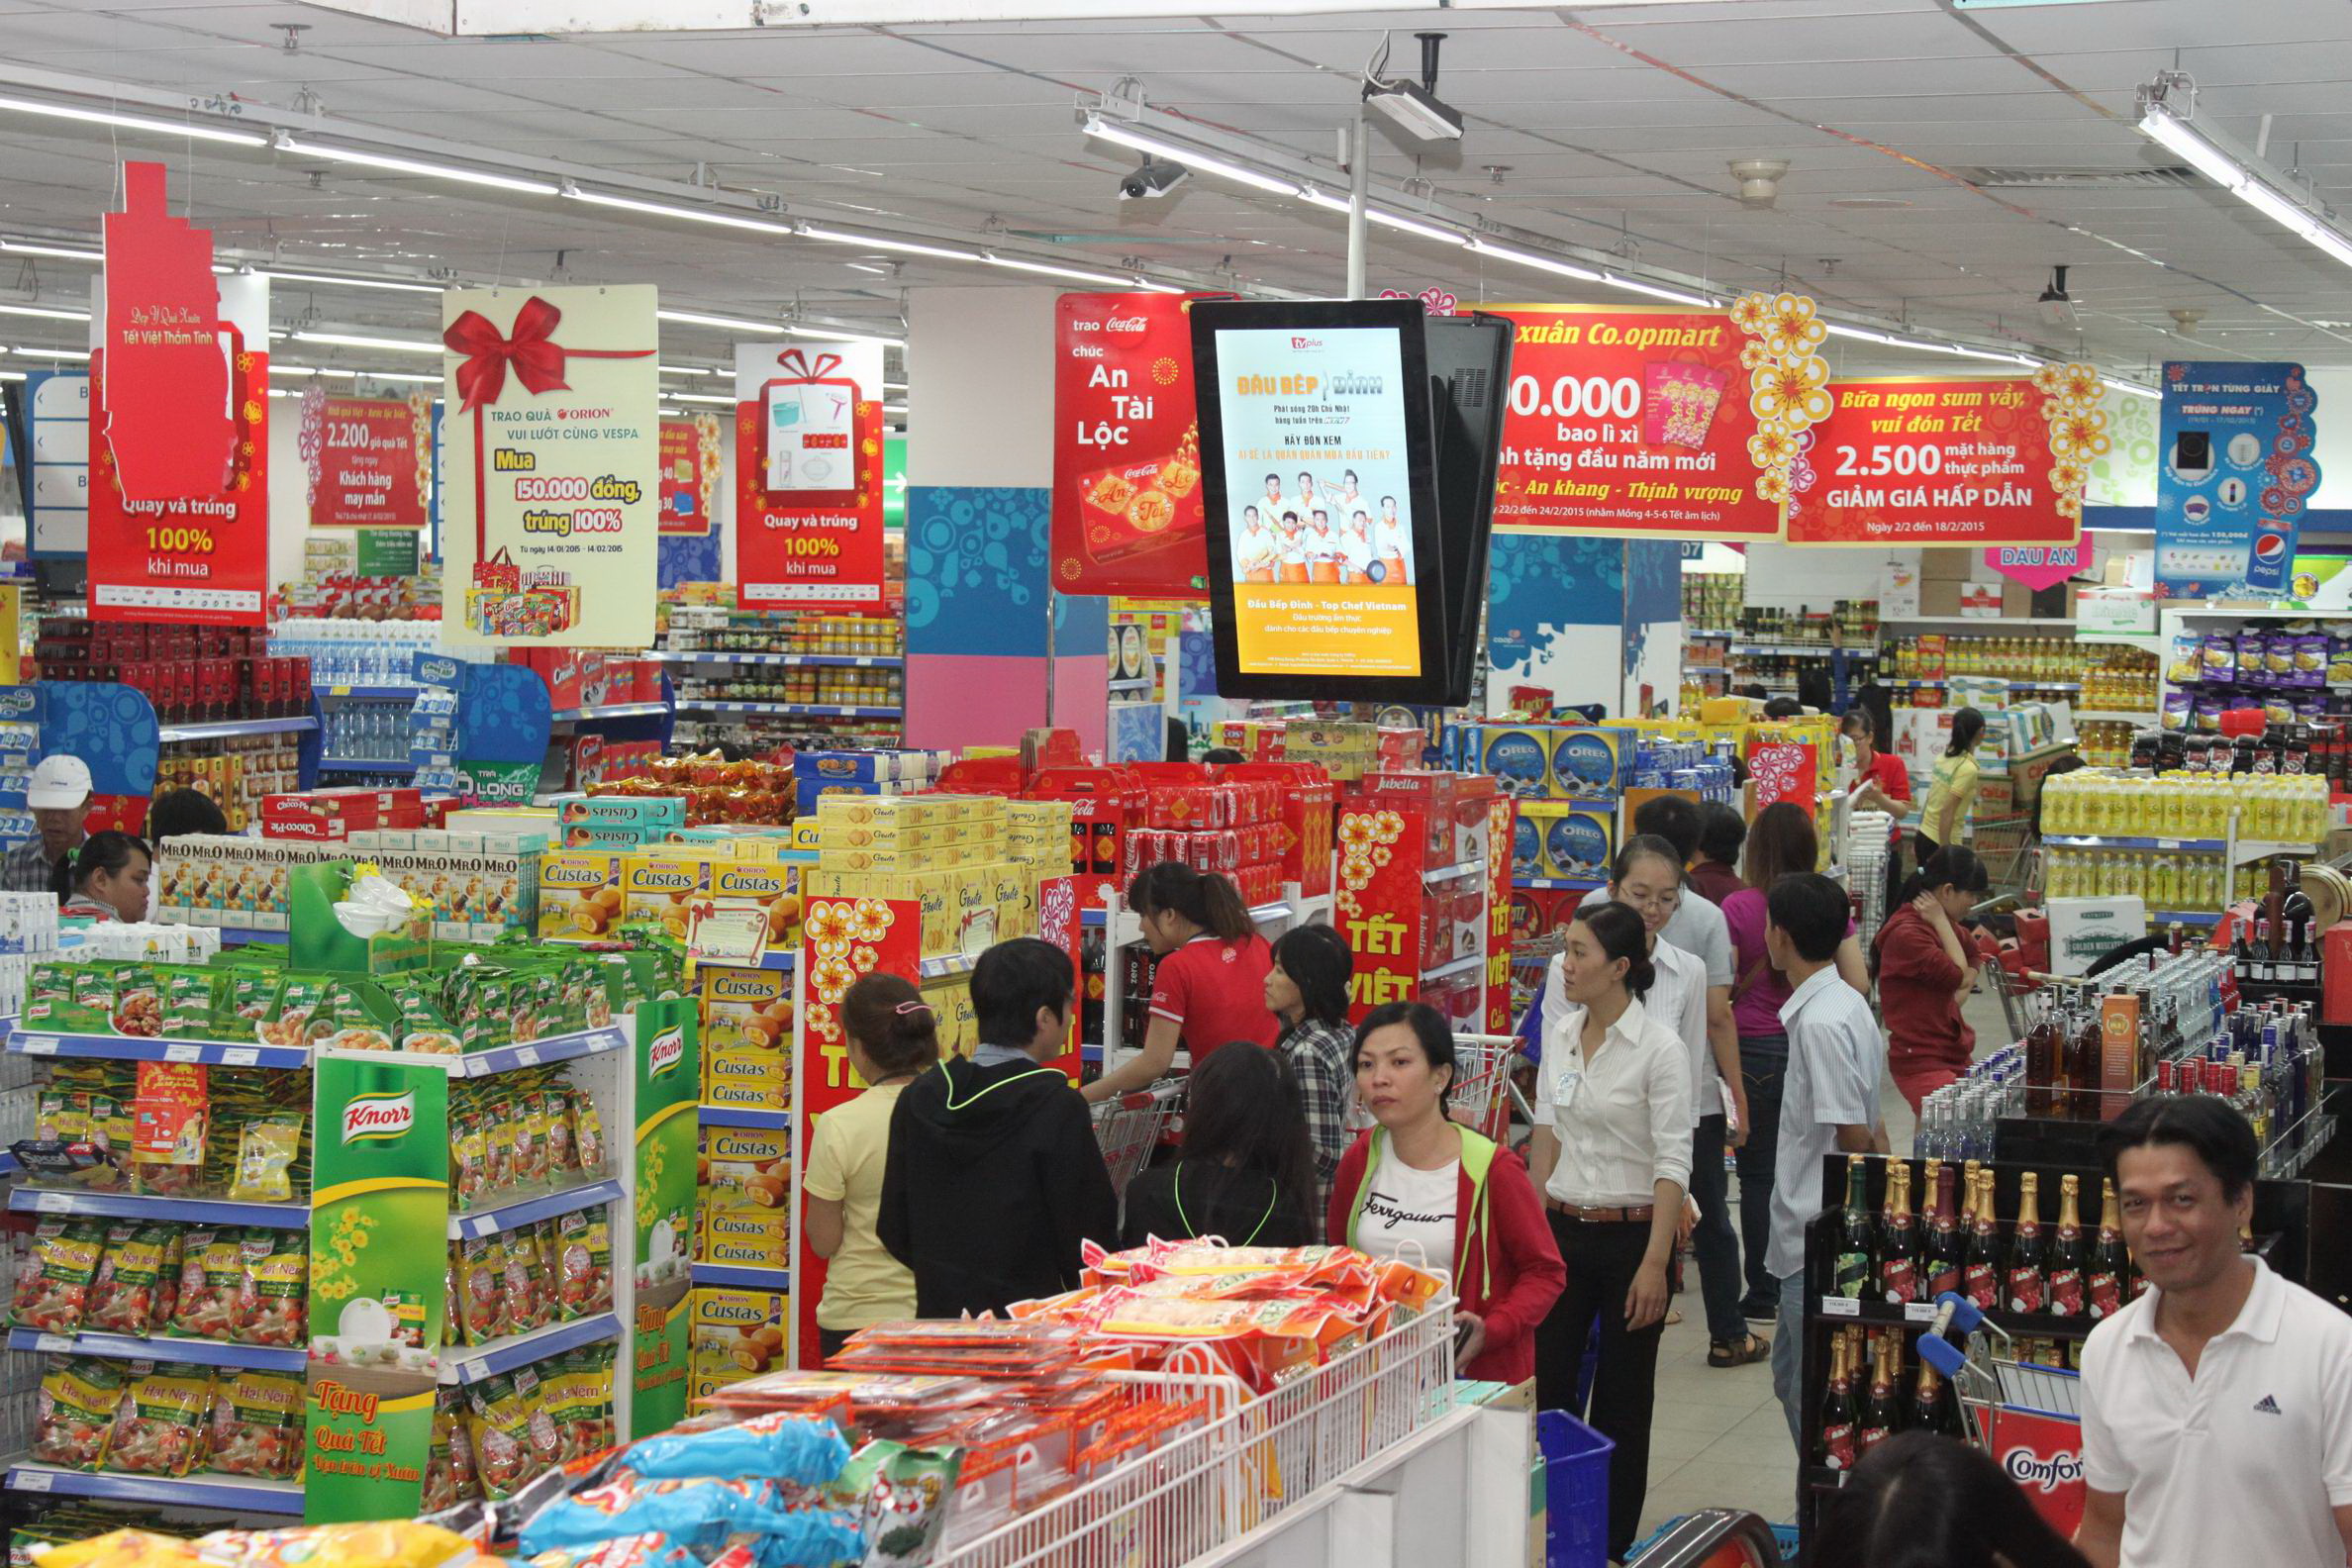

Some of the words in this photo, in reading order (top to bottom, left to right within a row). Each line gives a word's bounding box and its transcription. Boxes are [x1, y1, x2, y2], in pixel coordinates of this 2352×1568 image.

[1073, 320, 1101, 332] trao
[1106, 317, 1148, 333] Coca-Cola
[123, 328, 139, 344] Tết
[142, 331, 162, 346] Việt
[1516, 320, 1581, 344] xuân
[1588, 323, 1721, 350] Co.opmart
[1072, 344, 1104, 357] chúc
[1088, 364, 1127, 388] An
[1280, 372, 1320, 395] BẾP
[1504, 376, 1641, 419] 0.000
[1840, 391, 1880, 408] Bữa
[1886, 394, 1935, 411] ngon
[1940, 394, 1983, 406] sum
[491, 412, 522, 422] TRAO
[526, 408, 551, 422] QUÀ
[570, 409, 610, 419] ORION
[1111, 395, 1153, 420] Tài
[1290, 404, 1306, 414] sóng
[2182, 404, 2218, 415] TRÚNG
[2220, 406, 2252, 415] NGAY
[1871, 416, 1903, 433] vui
[1907, 415, 1946, 434] đón
[1951, 410, 1983, 433] Tết
[327, 423, 369, 447] 2.200
[396, 436, 408, 448] Tết
[508, 430, 526, 440] VUI
[531, 427, 559, 440] LƯỚT
[563, 427, 598, 439] CÙNG
[603, 429, 638, 439] VESPA
[1077, 421, 1129, 450] Lộc
[1323, 437, 1341, 445] XEM
[1558, 423, 1598, 443] bao
[1602, 423, 1616, 442] lì
[1619, 424, 1639, 442] xì
[495, 449, 535, 470] Mua
[1524, 450, 1571, 471] tặng
[1577, 447, 1617, 469] đầu
[1623, 452, 1671, 470] năm
[1675, 451, 1715, 470] mới
[1835, 445, 1941, 476] 2.500
[1945, 442, 1975, 459] mặt
[1978, 443, 2016, 459] hàng
[1944, 462, 1978, 477] thực
[1982, 459, 2024, 477] phẩm
[340, 471, 366, 485] Khách
[368, 472, 392, 490] hàng
[516, 478, 588, 500] 150.000
[591, 475, 641, 504] đồng,
[345, 495, 363, 509] may
[365, 489, 385, 505] mắn
[1525, 480, 1549, 495] An
[1553, 481, 1610, 501] khang
[1628, 482, 1679, 500] Thịnh
[1685, 487, 1743, 504] vượng
[1827, 485, 1885, 508] GIẢM
[1890, 484, 1927, 508] GIÁ
[1933, 483, 1979, 507] HẤP
[1984, 482, 2032, 507] DẪN
[123, 498, 164, 517] Quay
[168, 497, 187, 515] và
[191, 498, 237, 520] trúng
[1499, 506, 1519, 515] 22/2
[1520, 505, 1537, 516] đến
[1539, 506, 1584, 517] 24/2/2015
[1586, 506, 1615, 519] (nhằm
[1617, 507, 1643, 521] Mồng
[1645, 510, 1668, 519] 4-5-6
[1670, 508, 1684, 520] Tết
[1685, 510, 1700, 520] âm
[1701, 510, 1720, 523] lịch)
[524, 510, 571, 537] trúng
[573, 509, 622, 532] 100%
[764, 515, 800, 532] Quay
[802, 515, 819, 528] và
[821, 515, 858, 530] trúng
[1867, 523, 1894, 533] Ngày
[1895, 523, 1911, 532] 2/2
[1912, 522, 1933, 532] đến
[1935, 523, 1985, 532] 18/2/2015
[147, 528, 213, 551] 100%
[784, 538, 839, 556] 100%
[148, 557, 170, 575] khi
[175, 562, 209, 576] mua
[786, 561, 806, 574] khi
[809, 565, 836, 574] mua
[2254, 566, 2280, 577] pepsi
[1269, 599, 1287, 611] Bếp
[1321, 601, 1338, 611] Top
[1341, 601, 1363, 610] Chef
[1365, 601, 1407, 610] Vietnam
[1498, 745, 1536, 757] OREO
[1568, 746, 1607, 758] OREO
[477, 784, 524, 796] LONG
[1377, 777, 1420, 792] Jubella
[593, 808, 638, 820] Custas
[595, 832, 639, 843] Custas
[544, 865, 603, 883] Custas
[633, 868, 693, 888] Custas
[721, 872, 780, 891] Custas
[1492, 896, 1511, 937] TẾT
[1346, 913, 1408, 955] TẾT
[1488, 947, 1512, 990] VIỆT
[715, 977, 774, 996] Custas
[650, 1035, 682, 1067] Knorr
[714, 1058, 765, 1076] Custas
[346, 1103, 412, 1127] Knorr
[314, 1380, 379, 1423] Tặng
[315, 1425, 354, 1451] Quà
[358, 1426, 386, 1455] Tết
[384, 1463, 421, 1481] Xuân
[2006, 1450, 2083, 1489] Comfor
